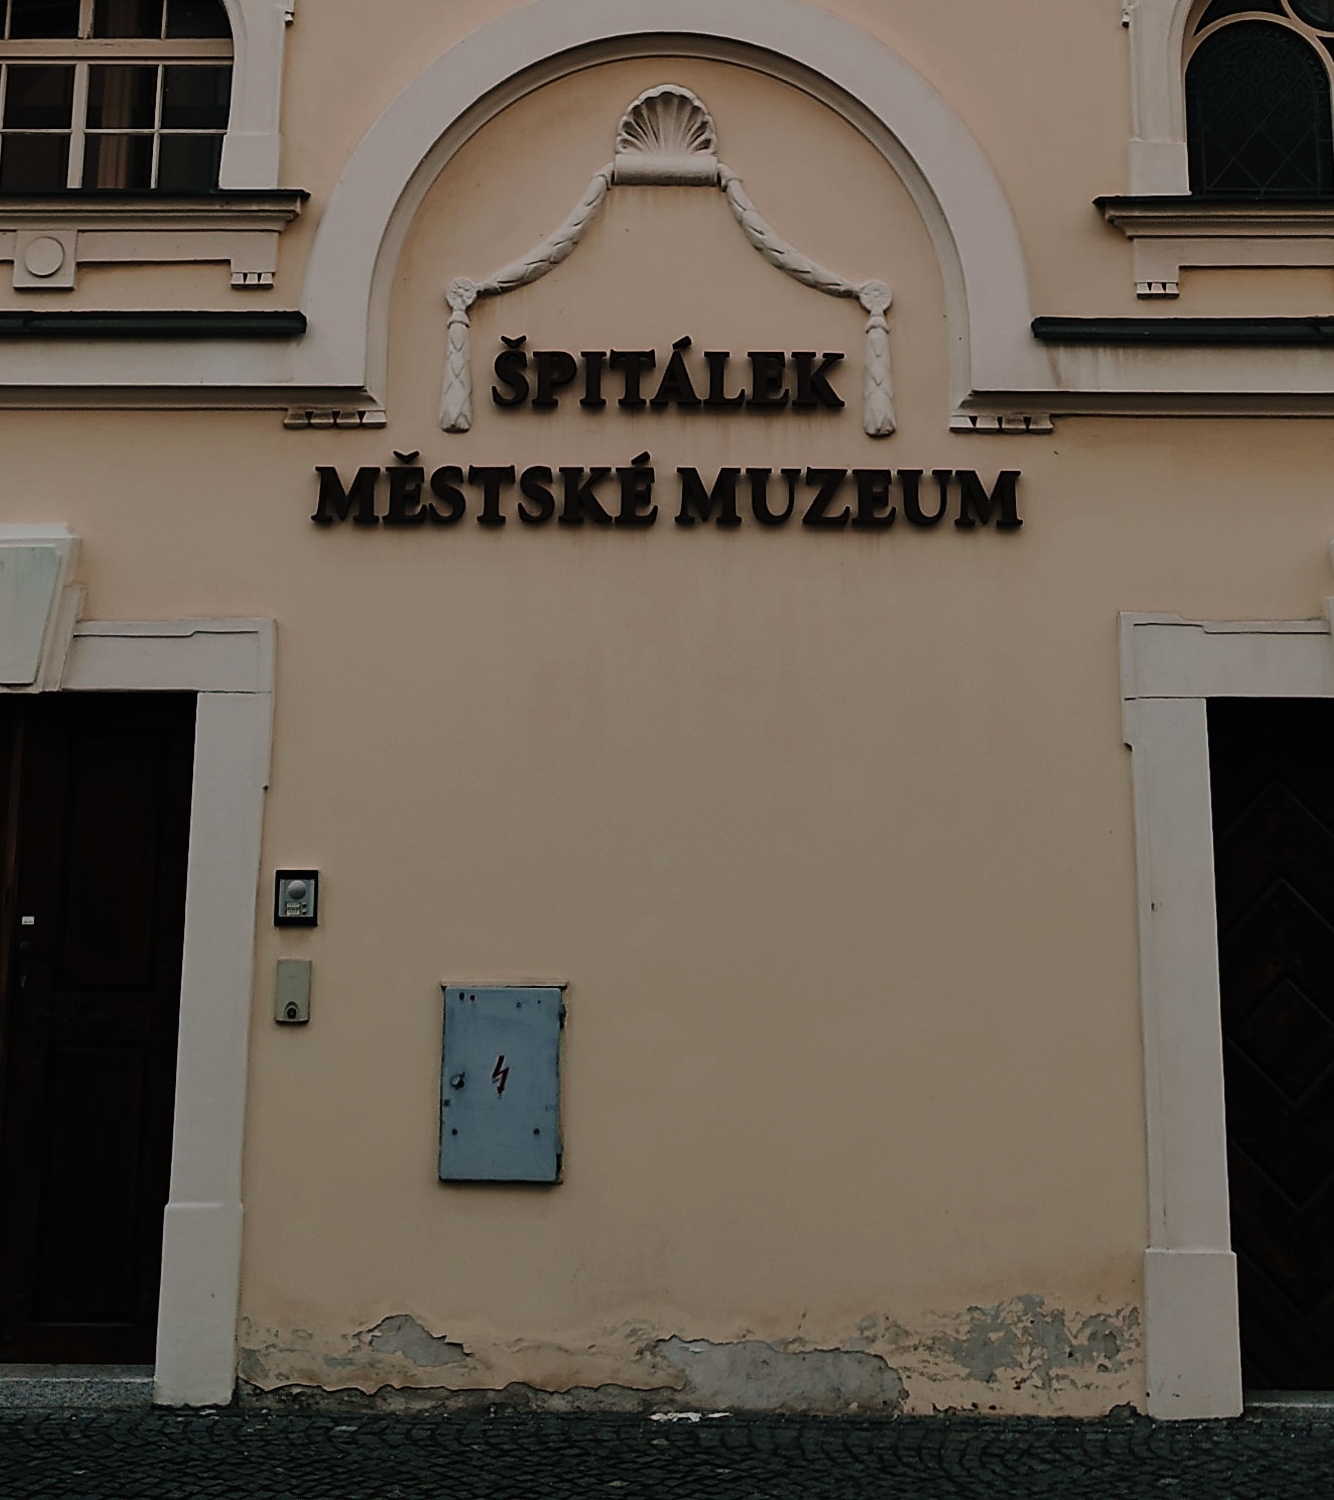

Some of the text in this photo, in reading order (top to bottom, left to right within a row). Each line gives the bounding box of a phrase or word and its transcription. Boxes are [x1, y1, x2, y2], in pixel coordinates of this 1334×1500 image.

[490, 335, 845, 408] ŠPITÁLEK
[310, 450, 1024, 528] MĚSTSKÉ MUZEUM
